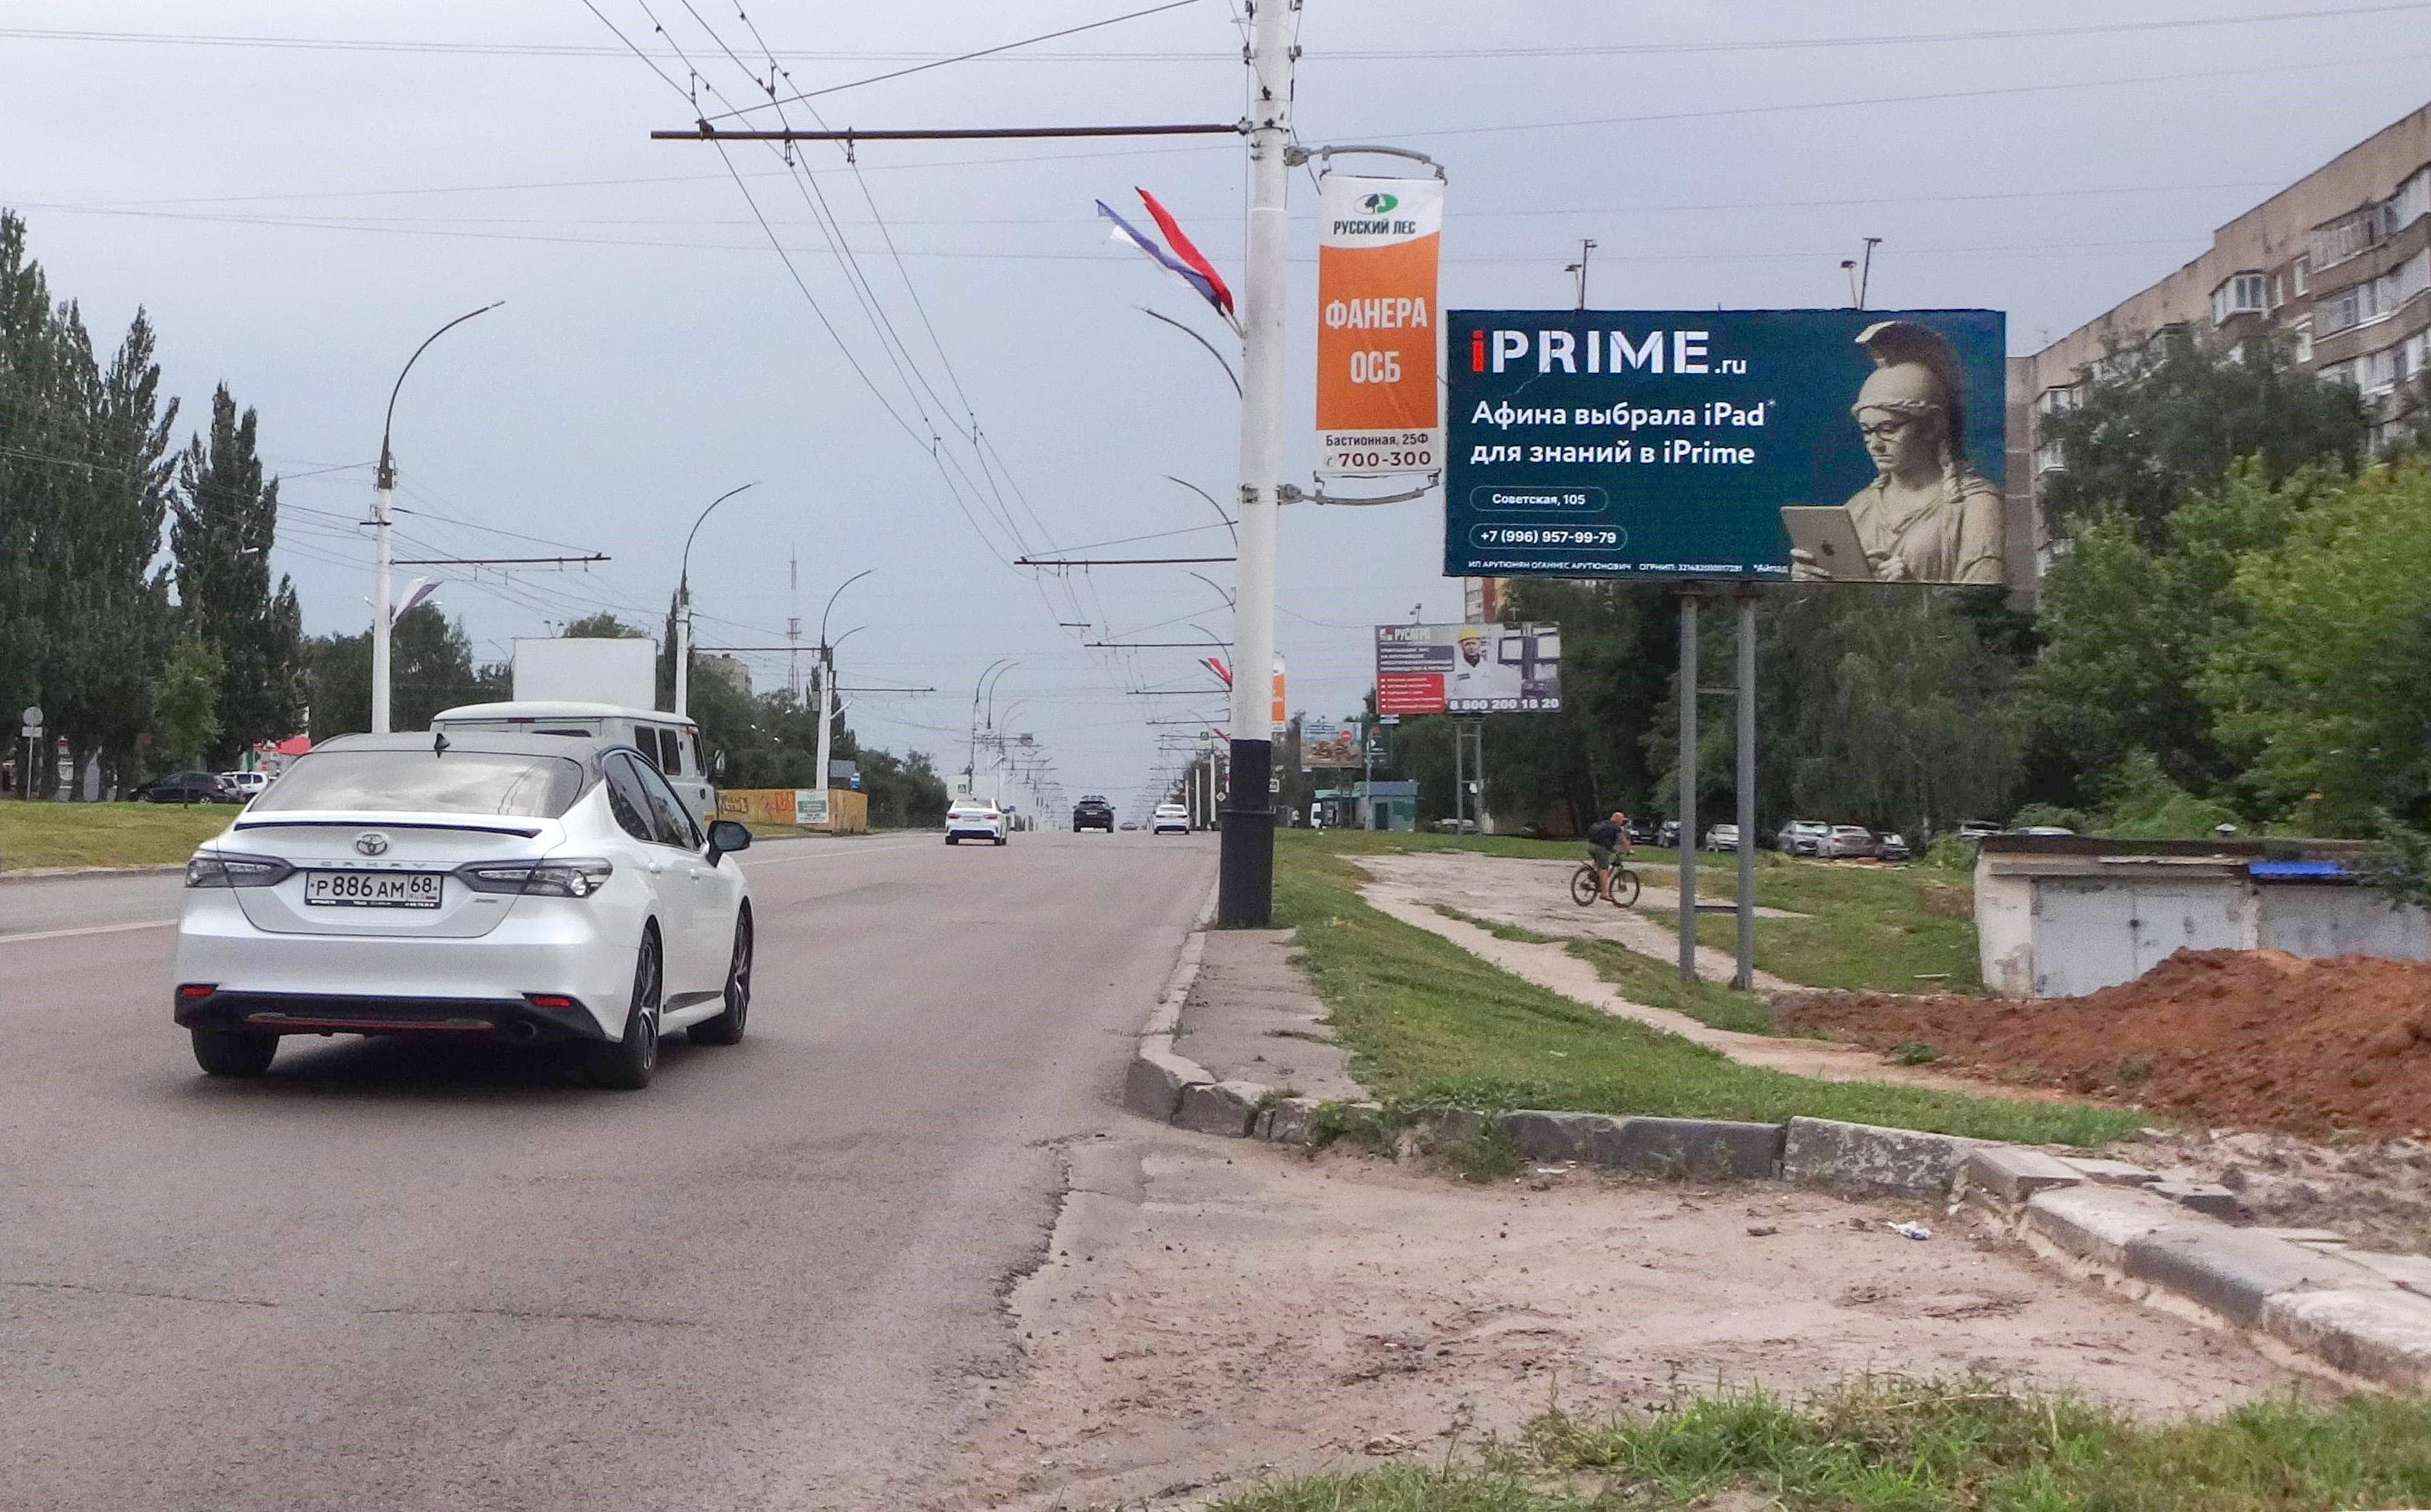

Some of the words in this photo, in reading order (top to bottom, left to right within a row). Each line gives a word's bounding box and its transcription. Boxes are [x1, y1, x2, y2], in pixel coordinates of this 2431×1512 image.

[1333, 220, 1389, 236] РУССКИЙ
[1392, 220, 1416, 235] ЛЕС
[1325, 296, 1429, 330] ФАНЕРА
[1349, 350, 1401, 384] ОСБ
[1471, 400, 1567, 430] Афина
[1575, 401, 1696, 431] выбрала
[1326, 434, 1399, 446] Бастионная,
[1338, 451, 1431, 467] 700-300
[1470, 445, 1522, 465] для
[1529, 440, 1632, 464] знаний
[1640, 446, 1655, 463] в
[1664, 439, 1756, 465] iPrime
[1492, 493, 1561, 507] Советская,
[1563, 494, 1586, 505] 105
[1481, 530, 1498, 542] +7
[1501, 529, 1538, 544] (996)
[1542, 531, 1617, 544] 957-99-79
[1449, 700, 1460, 711] 8
[1461, 699, 1489, 709] 800
[1491, 699, 1518, 709] 200
[1522, 699, 1539, 709] 18
[1541, 698, 1560, 709] 20
